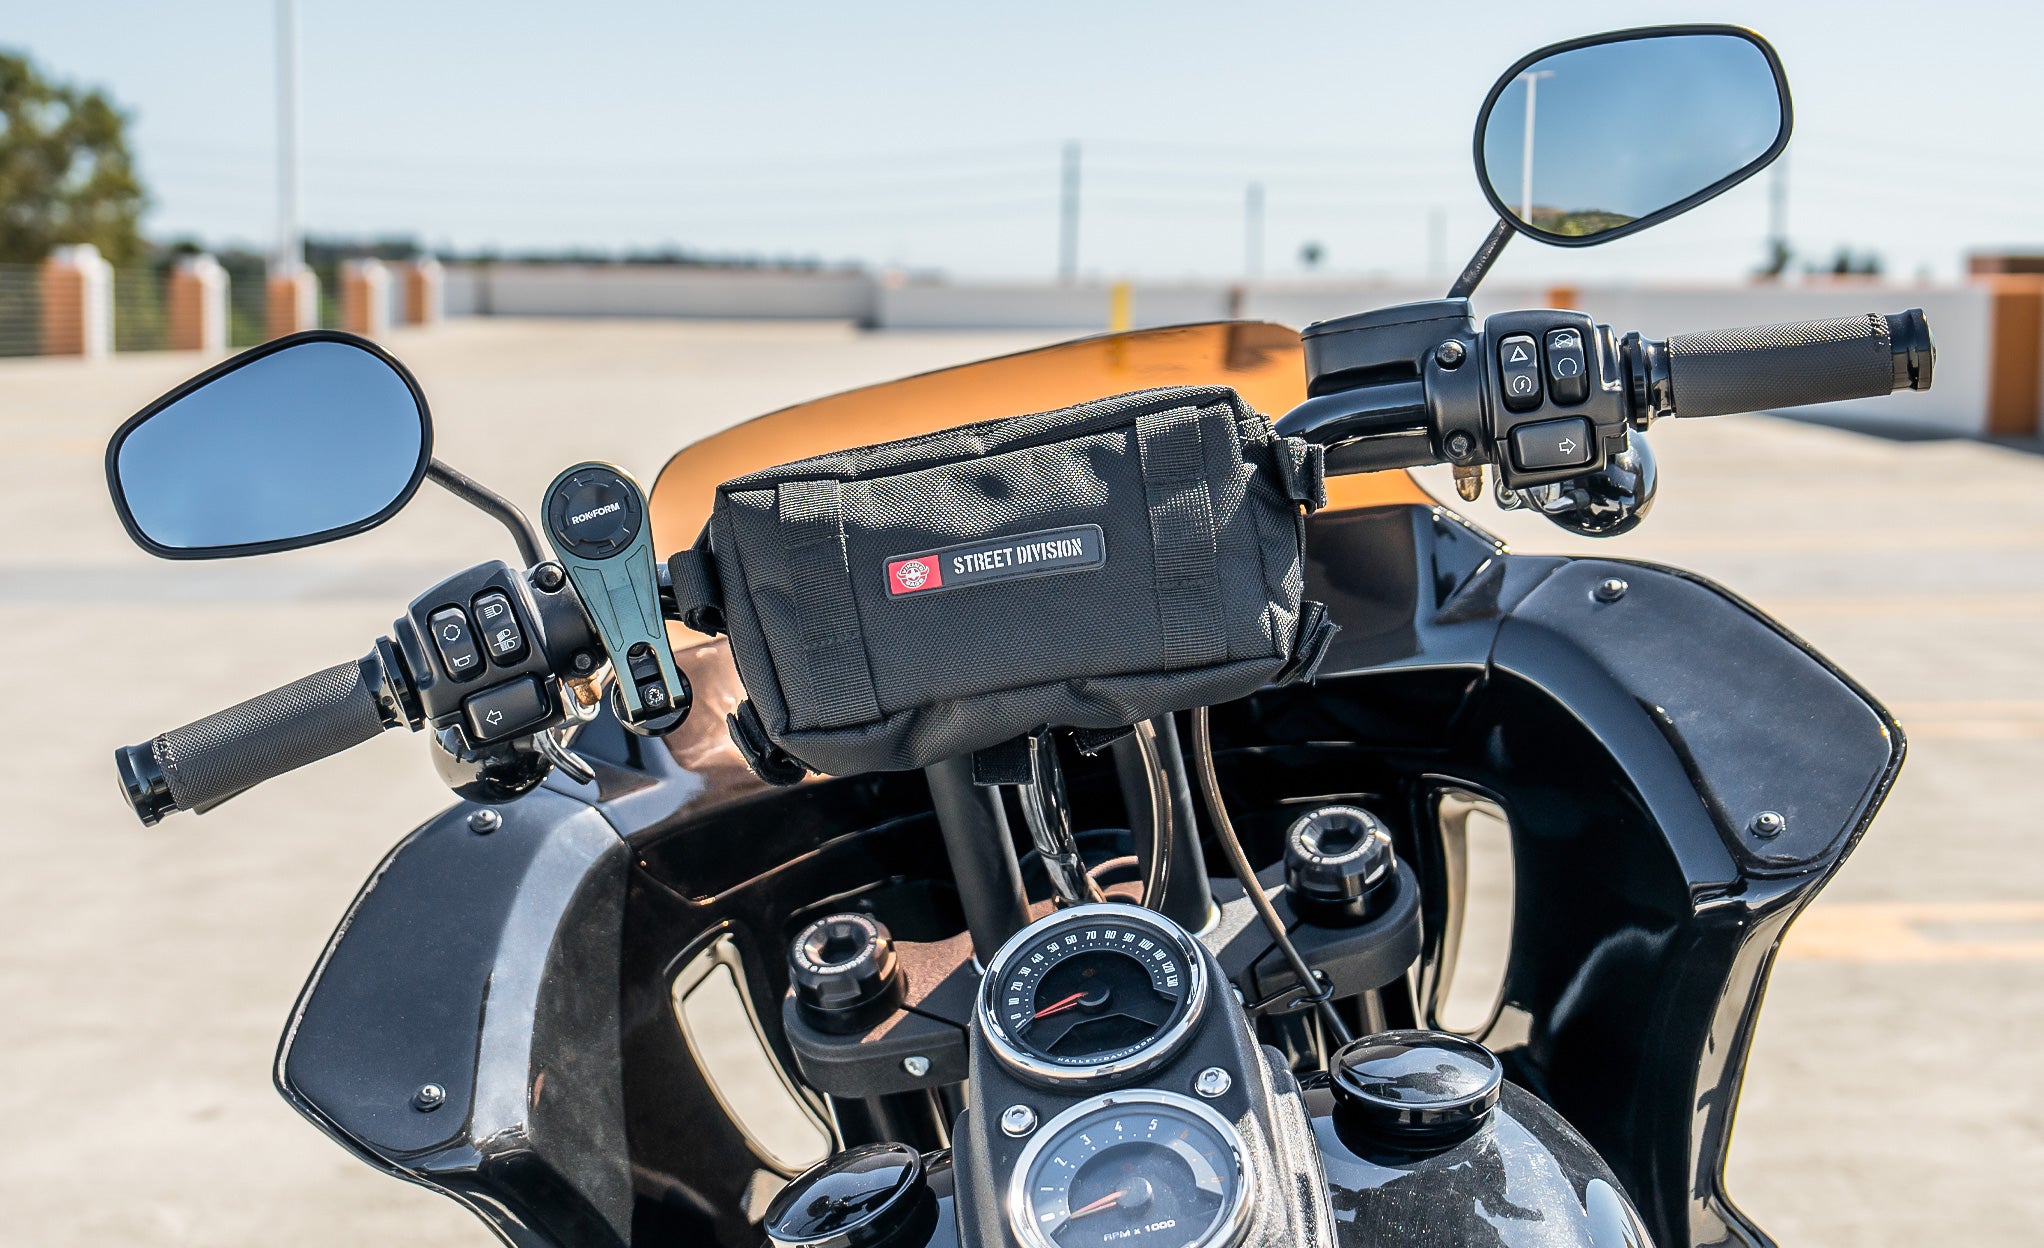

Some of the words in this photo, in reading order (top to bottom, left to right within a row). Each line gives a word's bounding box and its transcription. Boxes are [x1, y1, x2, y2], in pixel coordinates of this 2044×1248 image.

[953, 547, 1013, 575] STREET
[1016, 537, 1083, 565] DIVISION
[1064, 934, 1078, 945] 60
[1085, 930, 1097, 940] 70
[1104, 930, 1117, 940] 80
[1121, 932, 1136, 943] 90
[1046, 941, 1060, 953] 50
[1138, 938, 1155, 951] 100
[1030, 952, 1045, 964] 40
[1152, 948, 1167, 961] 110
[1017, 966, 1032, 977] 30
[1161, 960, 1176, 974] 120
[1010, 981, 1024, 992] 20
[1166, 974, 1179, 988] 130
[1008, 997, 1020, 1006] 10
[1010, 1012, 1022, 1020] 0
[1053, 1156, 1068, 1167] 2
[1079, 1133, 1092, 1146] 3
[1114, 1120, 1123, 1132] 4
[1148, 1118, 1158, 1131] 5
[1103, 1229, 1131, 1242] RPM
[1144, 1219, 1176, 1233] 1000
